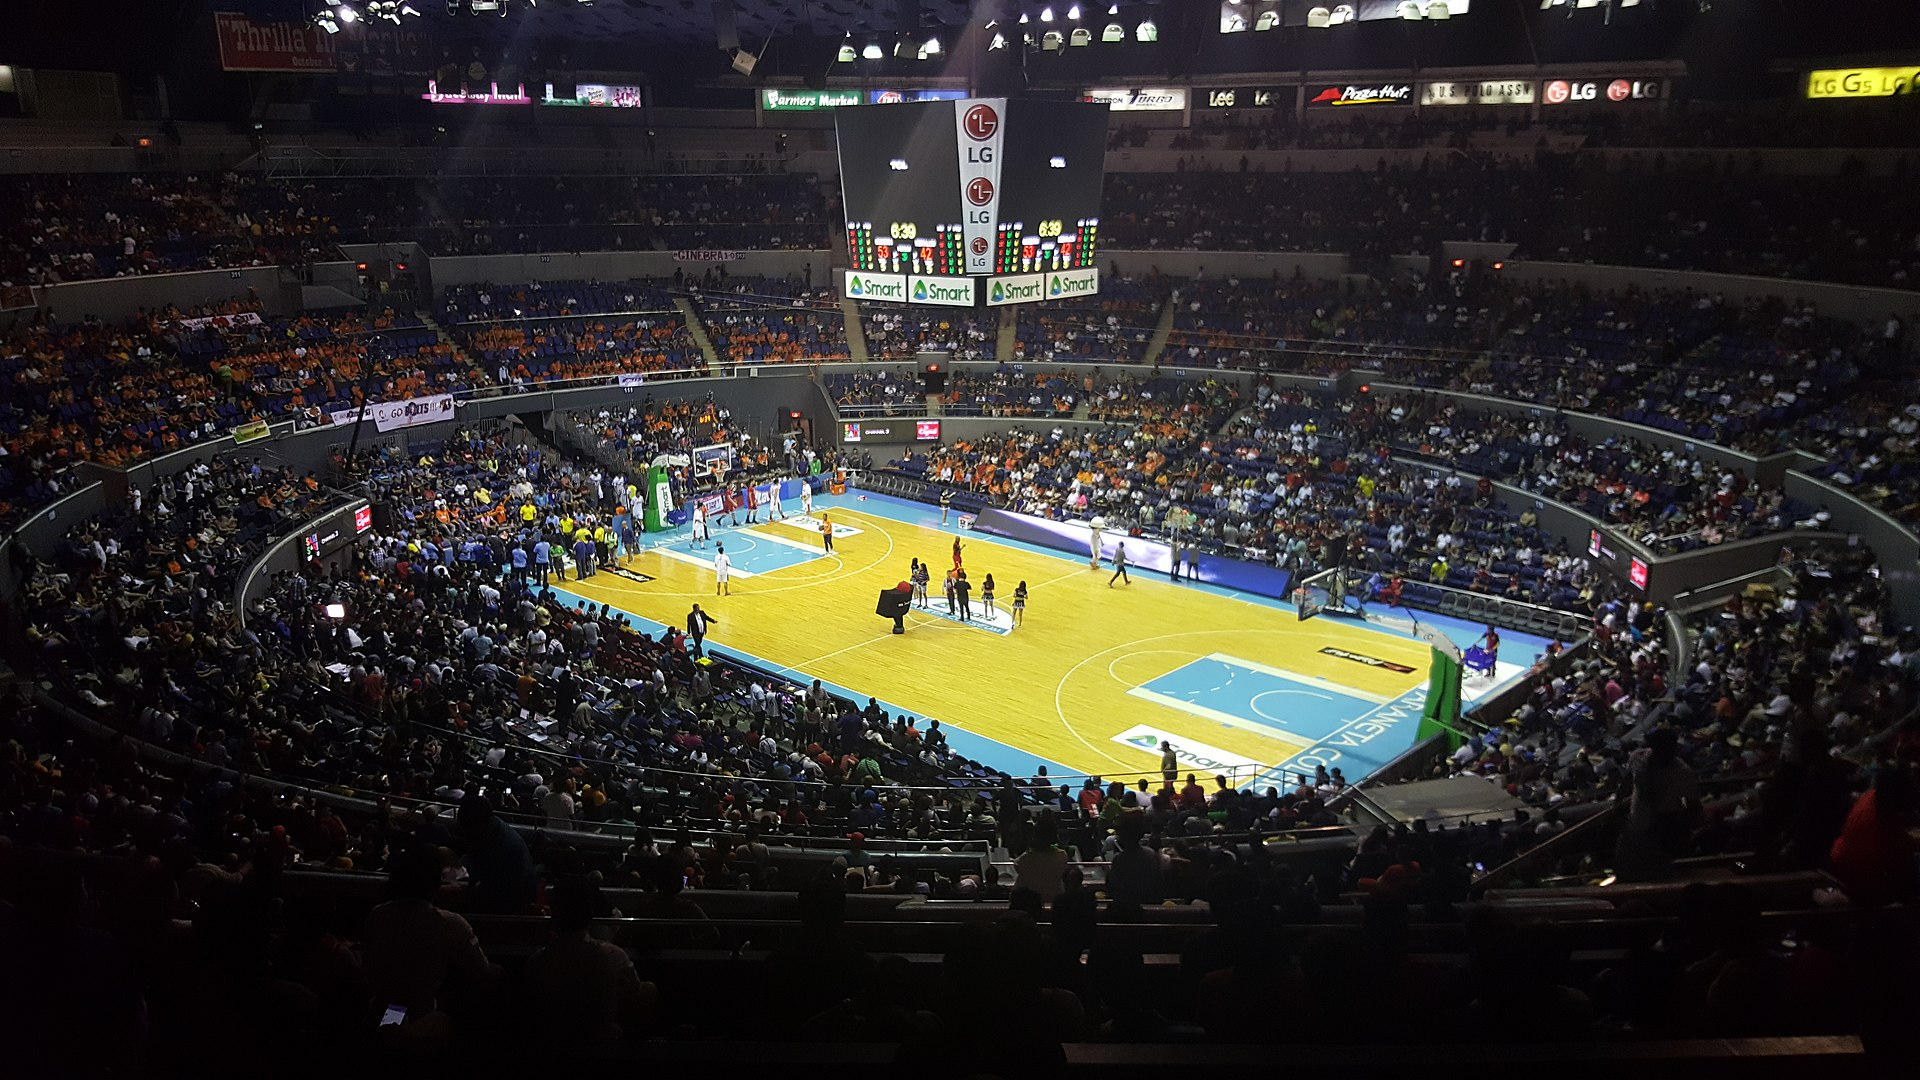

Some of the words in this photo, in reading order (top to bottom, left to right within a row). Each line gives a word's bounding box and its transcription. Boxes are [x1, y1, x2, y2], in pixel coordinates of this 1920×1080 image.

[1340, 86, 1378, 101] Pizza
[1570, 82, 1597, 100] LG
[1632, 81, 1659, 99] LG
[1813, 80, 1836, 94] LG
[767, 90, 816, 108] Farmers
[818, 95, 859, 107] Market
[1208, 90, 1236, 106] Lee
[968, 147, 993, 163] LG
[969, 211, 990, 224] LG
[890, 222, 916, 240] 6:39
[1038, 220, 1062, 238] 6:39
[877, 245, 889, 258] 53
[920, 247, 933, 260] 42
[1023, 245, 1035, 258] 53
[1060, 242, 1072, 256] 42
[972, 258, 986, 267] LG
[865, 279, 902, 298] Smart
[1005, 281, 1040, 299] Smart
[1063, 275, 1095, 293] Smart
[929, 283, 970, 302] Smart
[391, 408, 403, 419] GO
